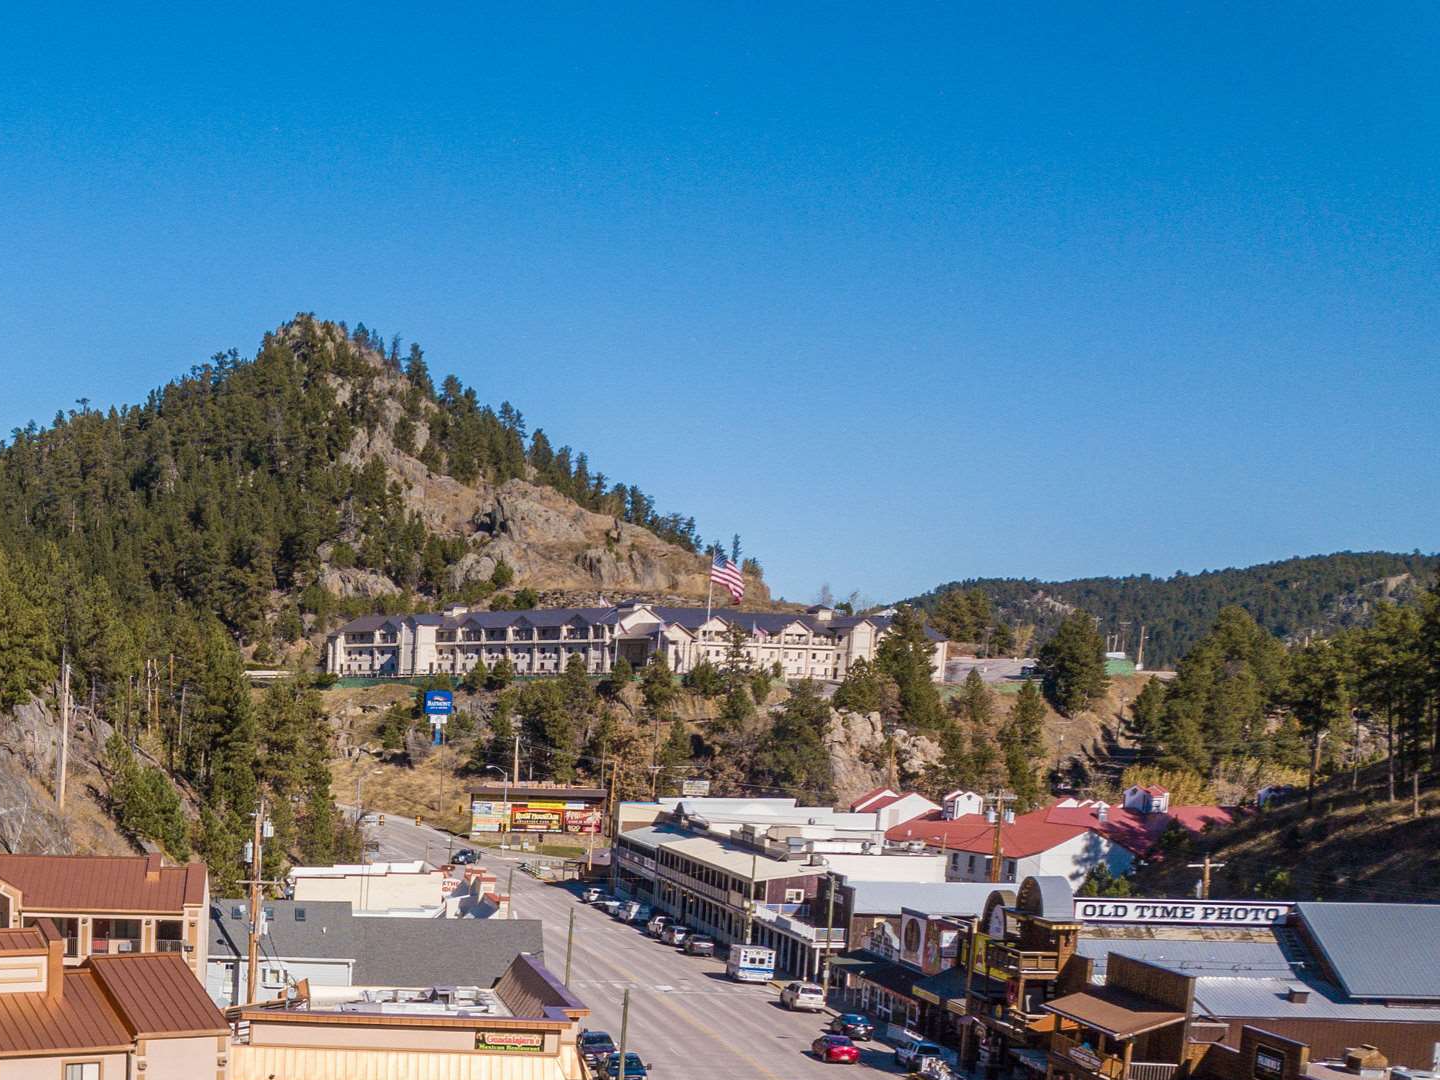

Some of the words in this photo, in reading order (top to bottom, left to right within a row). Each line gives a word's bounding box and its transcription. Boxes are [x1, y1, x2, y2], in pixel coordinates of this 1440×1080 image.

[1083, 904, 1128, 918] OLD
[1134, 905, 1195, 919] TIME
[1201, 907, 1280, 921] PHOTO
